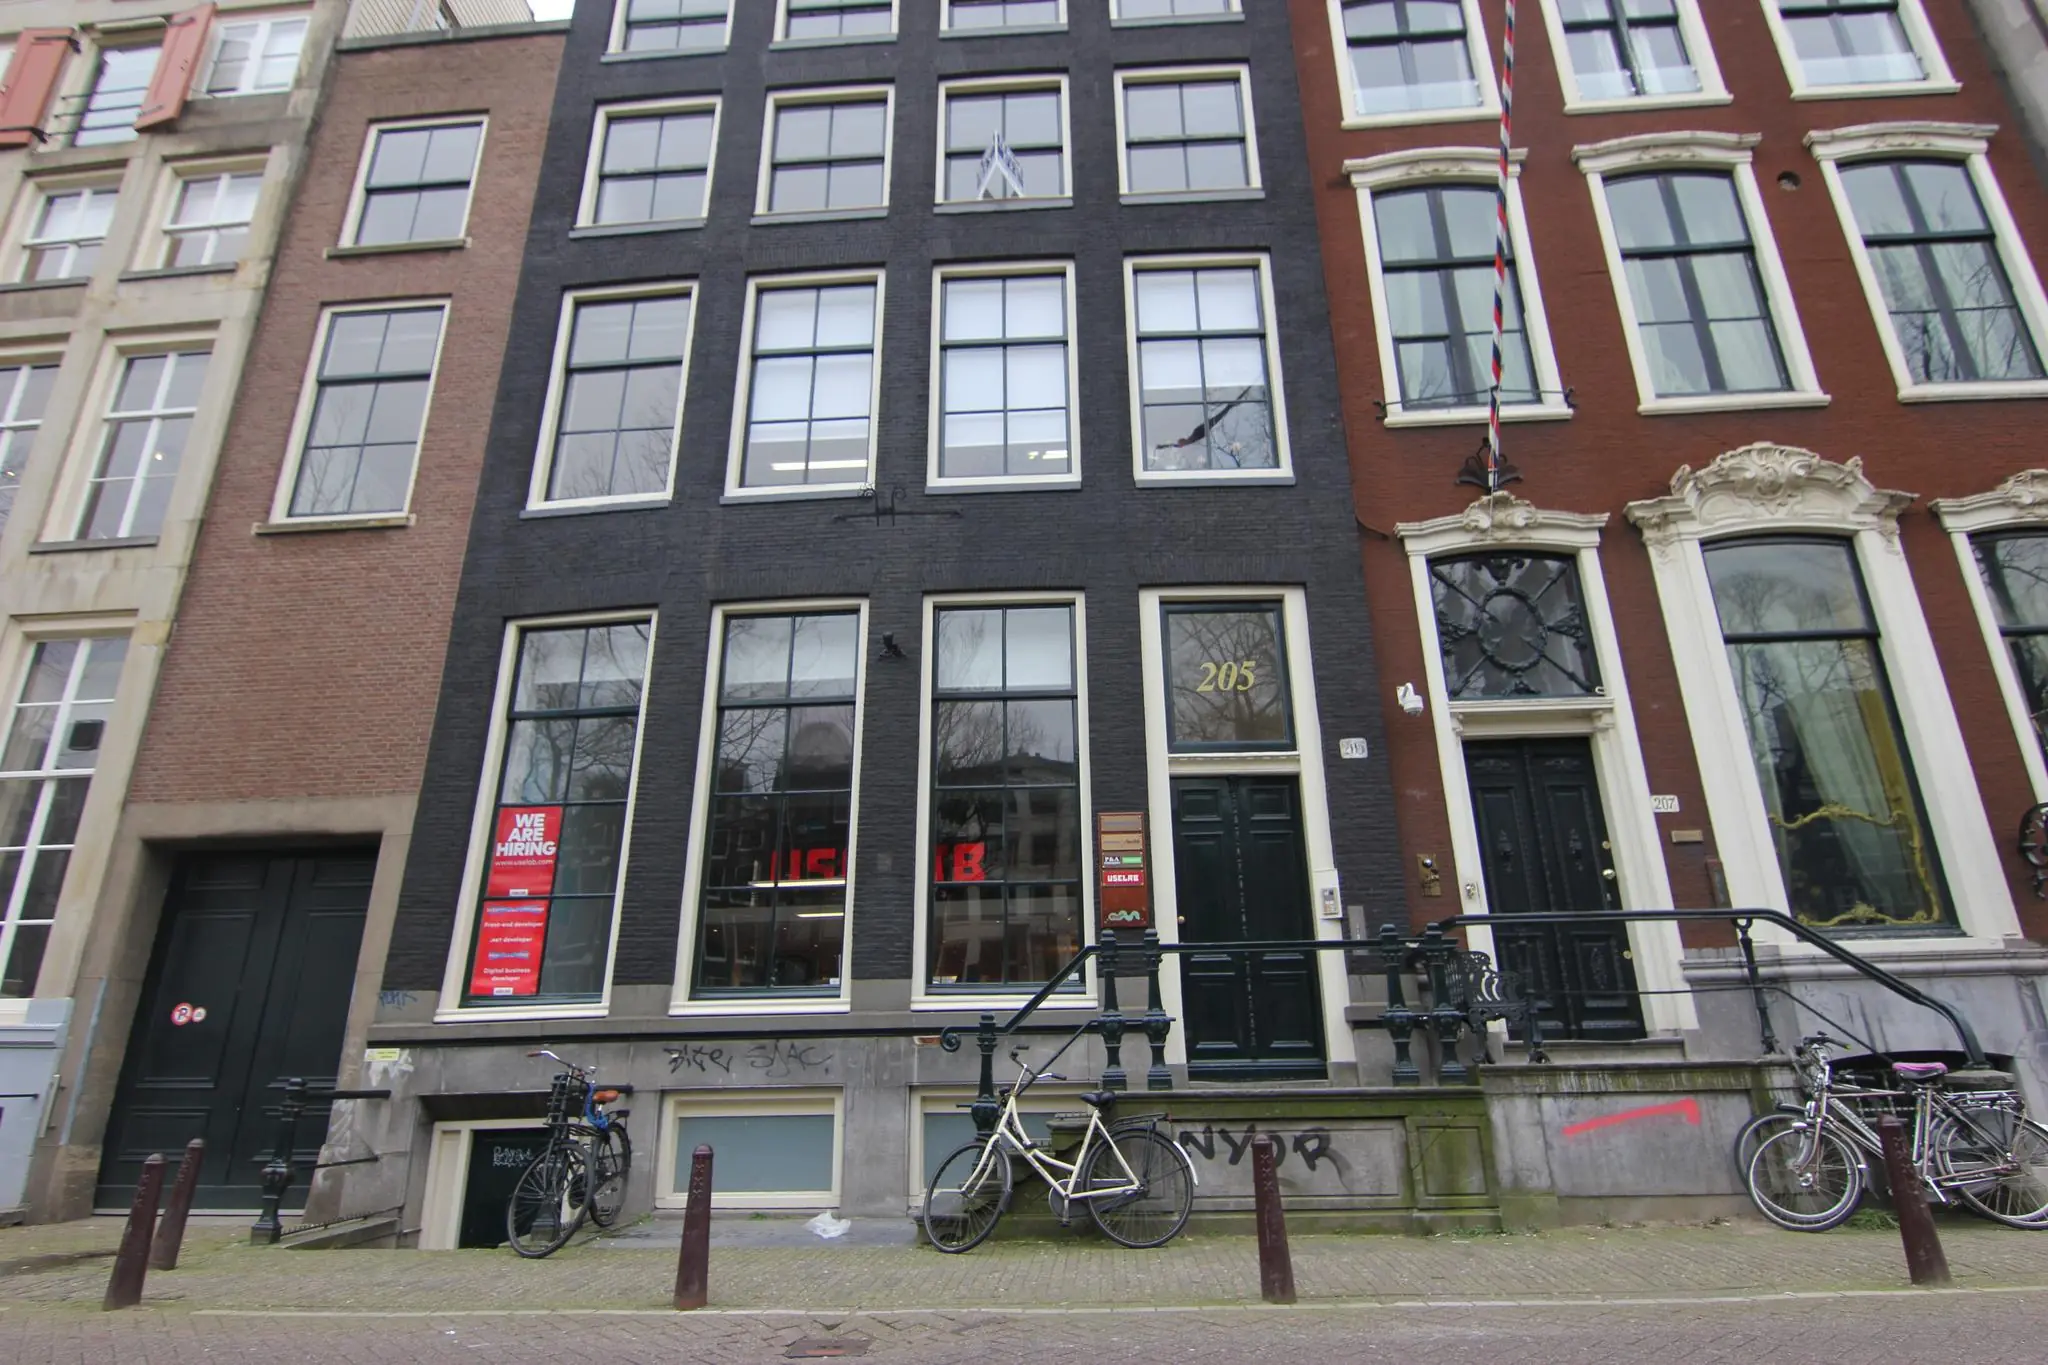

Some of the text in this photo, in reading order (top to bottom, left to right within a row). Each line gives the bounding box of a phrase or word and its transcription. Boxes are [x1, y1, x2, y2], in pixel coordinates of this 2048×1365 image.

[1196, 660, 1256, 692] 205
[1653, 797, 1676, 809] 207
[515, 813, 546, 828] WE
[507, 827, 545, 841] ARE
[495, 840, 557, 857] HIRING
[1107, 874, 1139, 882] USELAB
